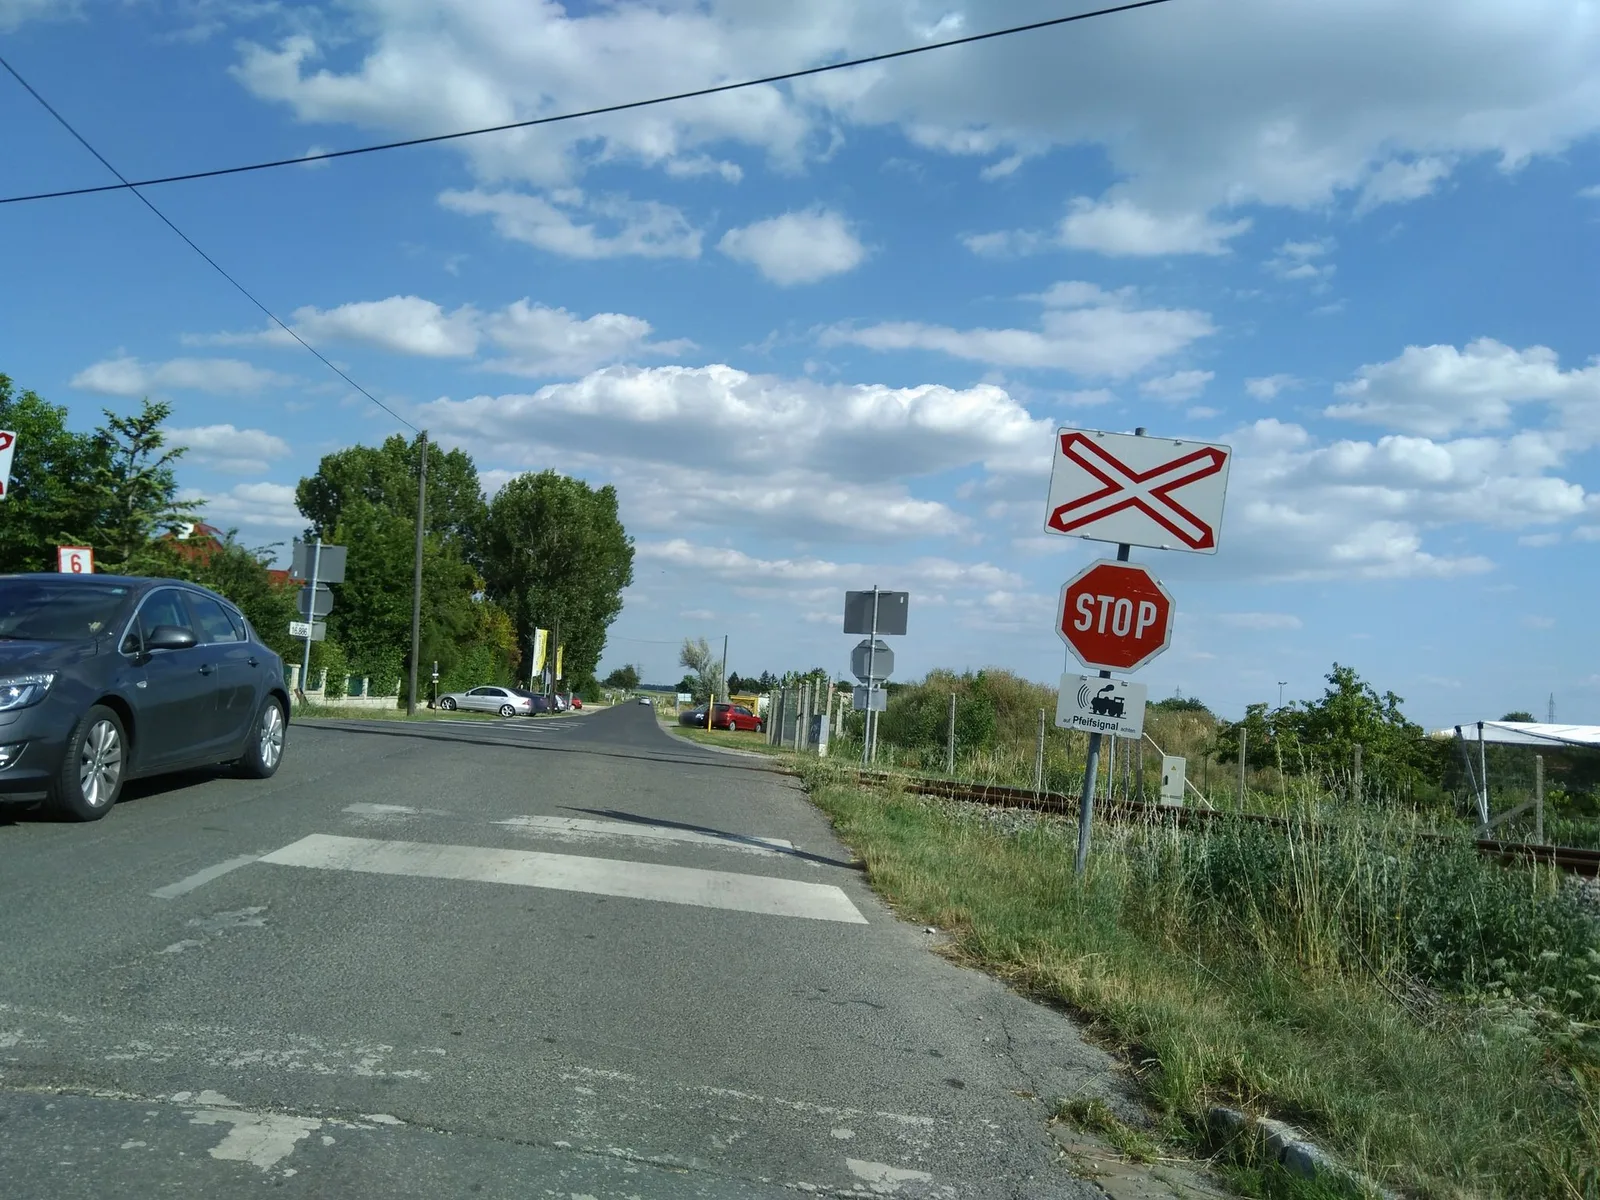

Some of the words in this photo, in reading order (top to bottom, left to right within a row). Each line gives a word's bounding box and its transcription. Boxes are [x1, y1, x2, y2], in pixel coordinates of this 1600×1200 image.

[70, 553, 82, 574] 6
[1073, 592, 1157, 639] STOP
[1072, 715, 1119, 731] Pfeifsignal
